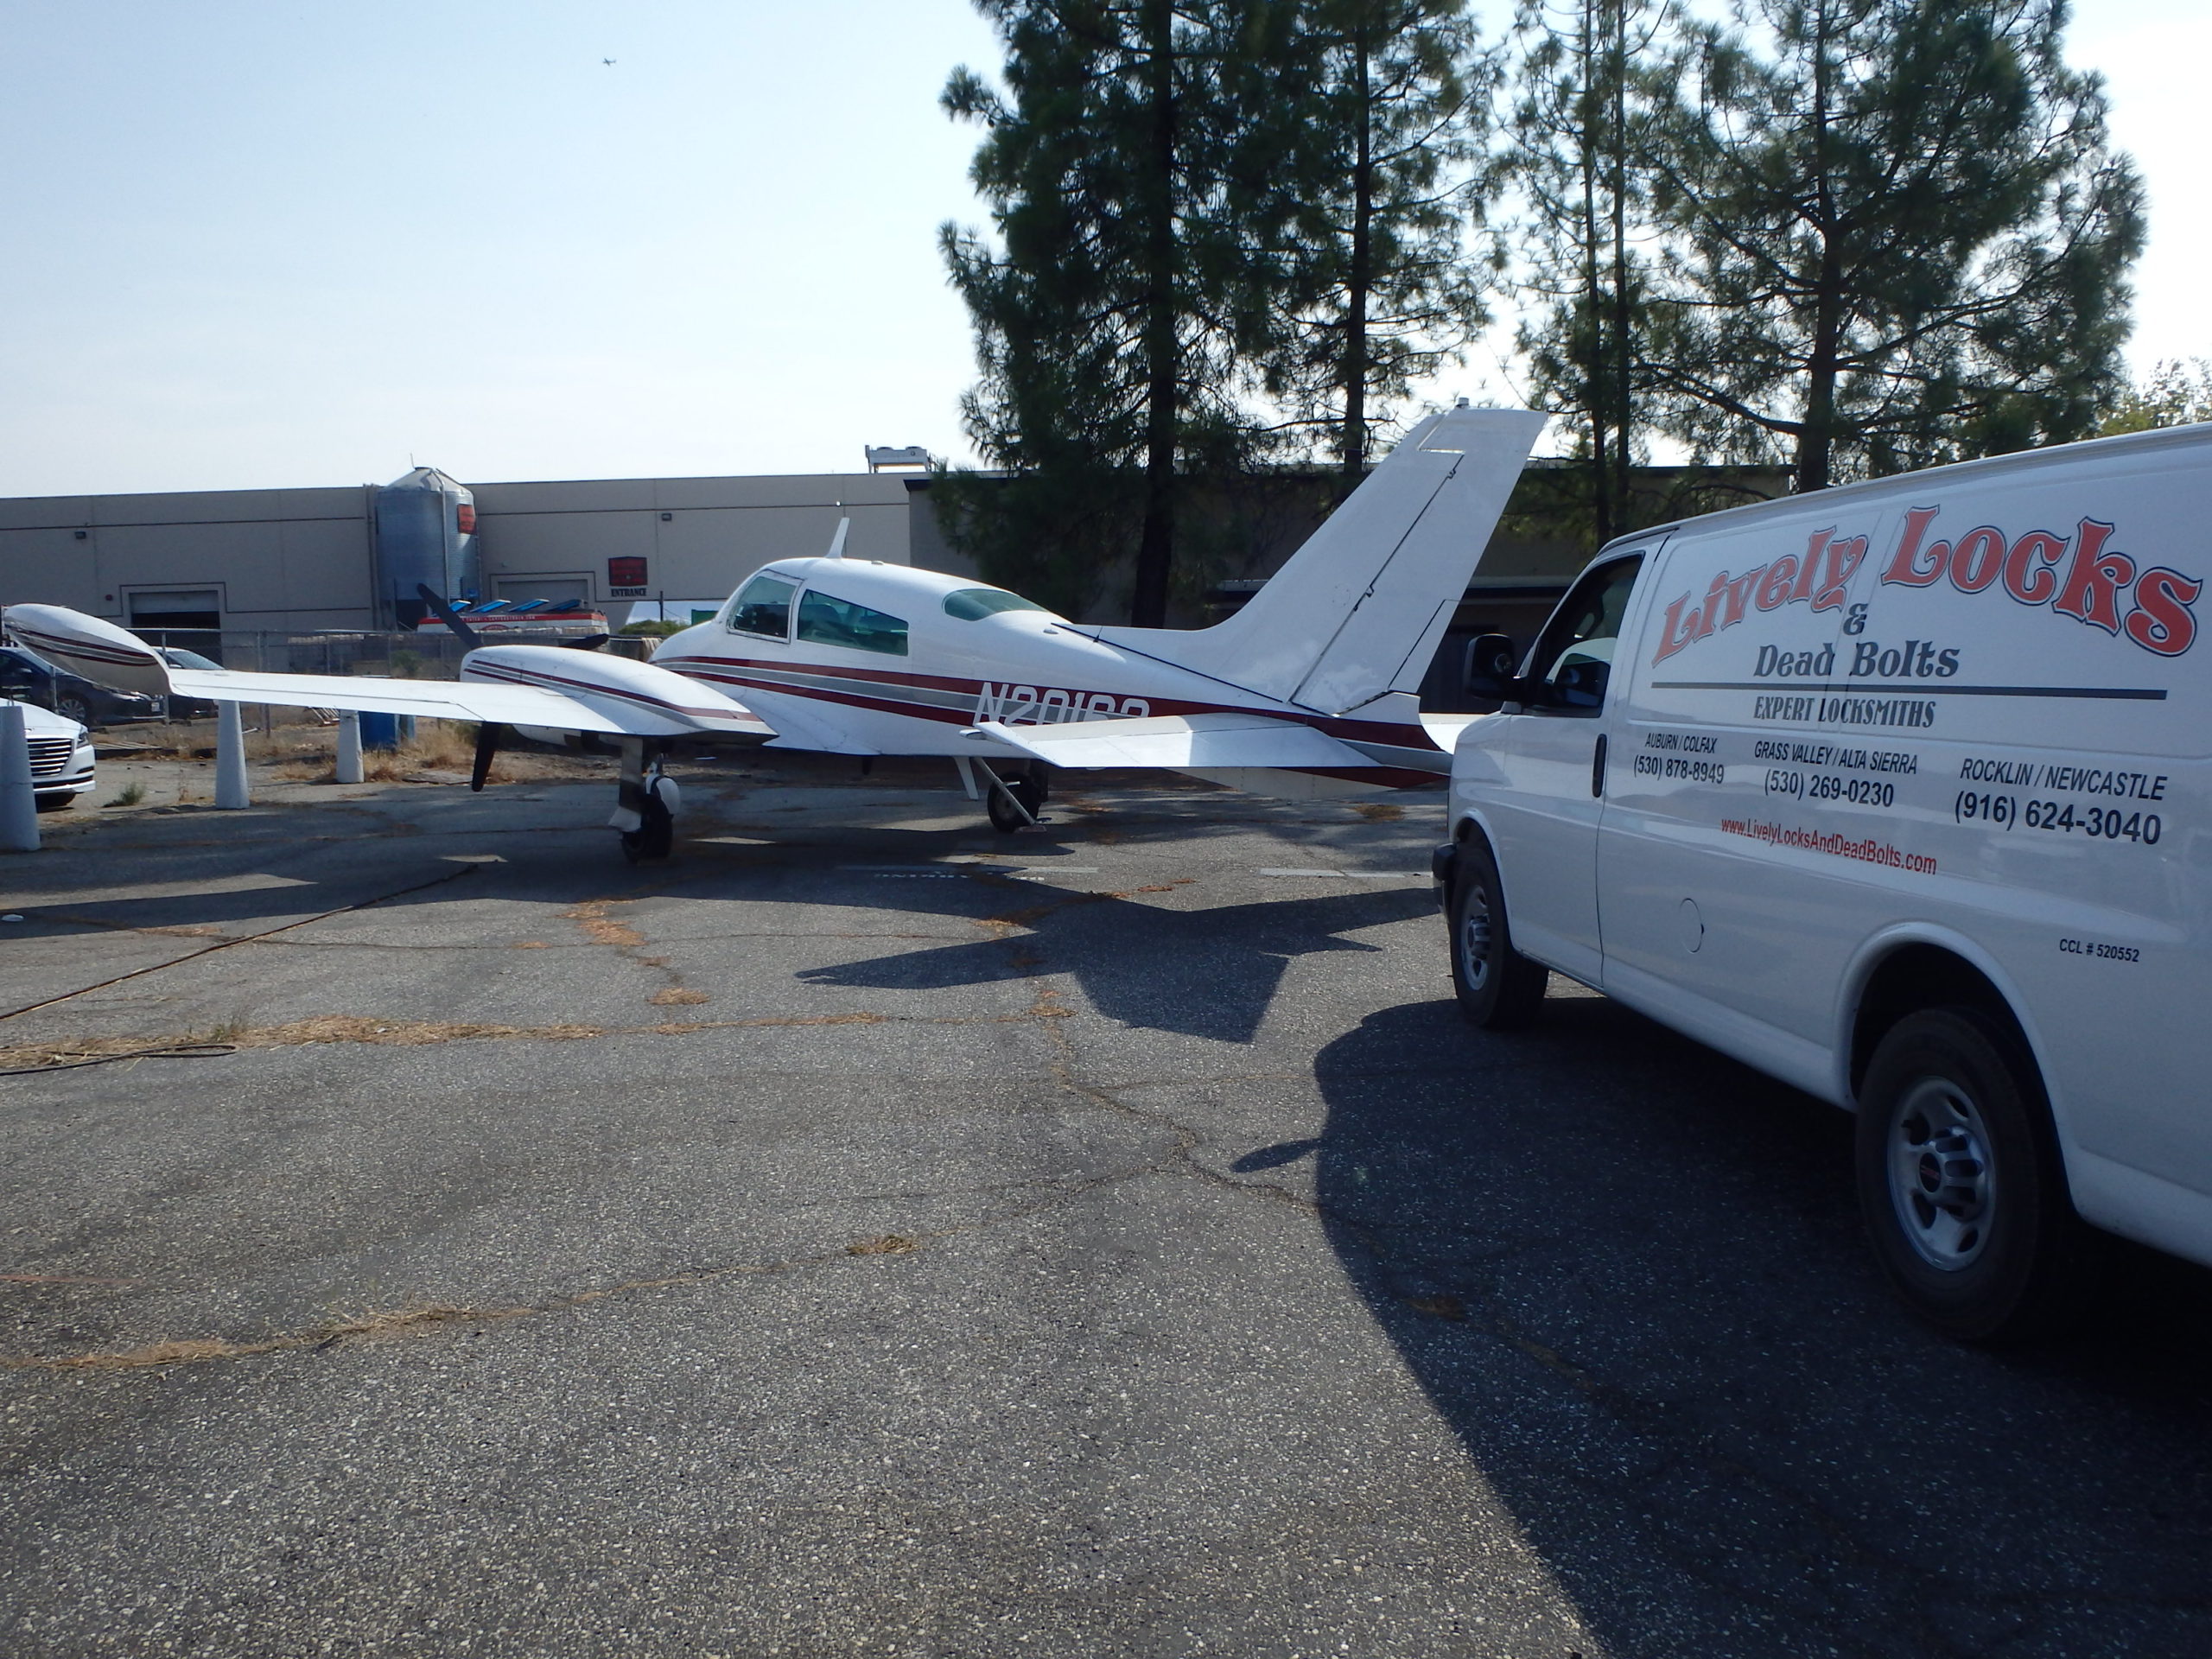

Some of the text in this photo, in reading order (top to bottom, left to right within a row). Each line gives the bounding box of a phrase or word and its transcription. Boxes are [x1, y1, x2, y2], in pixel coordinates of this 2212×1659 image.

[610, 588, 647, 597] ENTRANCE
[1651, 504, 2202, 669] Lively Locks
[1842, 603, 1868, 635] &
[1753, 639, 1961, 678] Dead Bolts
[1753, 696, 1936, 728] EXPERT LOCKSMITHS
[1633, 754, 1725, 785] (530) 878-8949
[1754, 740, 1789, 761] GRASS
[1791, 743, 1833, 766] VALLEY
[1838, 747, 1867, 770] ALTA
[1869, 751, 1917, 775] SIERRA
[1764, 768, 1895, 808] (530) 269-0230
[1960, 758, 2035, 786] ROCKLIN
[2044, 766, 2168, 801] NEWCASTLE
[1955, 791, 2161, 845] (916) 624-3040
[1721, 818, 1937, 875] www.LivelyLocksAndDeadBolts.com
[2059, 938, 2140, 963] CCL # 520552
